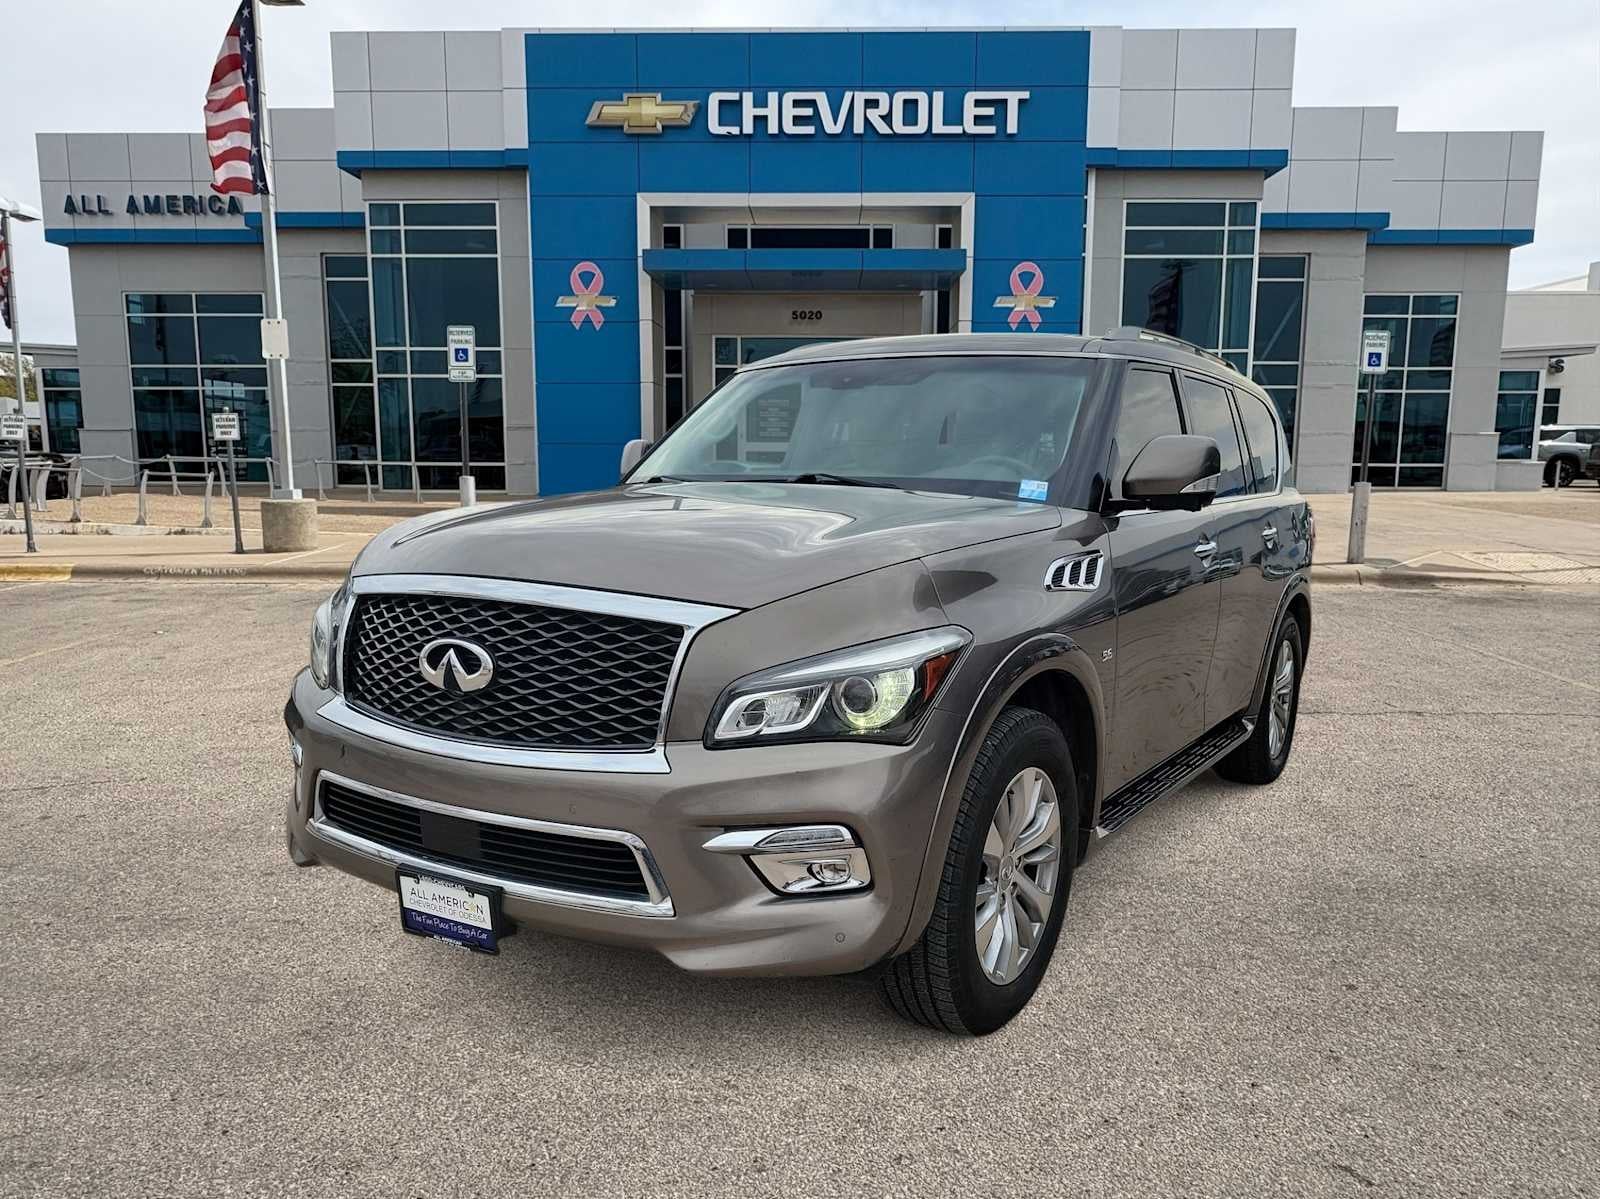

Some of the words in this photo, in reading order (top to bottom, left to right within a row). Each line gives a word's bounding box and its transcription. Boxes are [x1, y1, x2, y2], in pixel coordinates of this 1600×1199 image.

[707, 90, 1030, 136] CHEVROLET
[64, 194, 112, 215] ALL
[791, 310, 823, 320] 5020
[410, 887, 429, 901] ALL
[409, 898, 448, 914] CHEVROLET
[448, 908, 456, 917] OF
[459, 910, 488, 925] ODESSA
[411, 912, 422, 922] The
[433, 918, 449, 930] Place
[449, 922, 457, 931] To
[457, 924, 471, 938] Buy
[471, 929, 478, 937] A
[478, 930, 488, 940] Car
